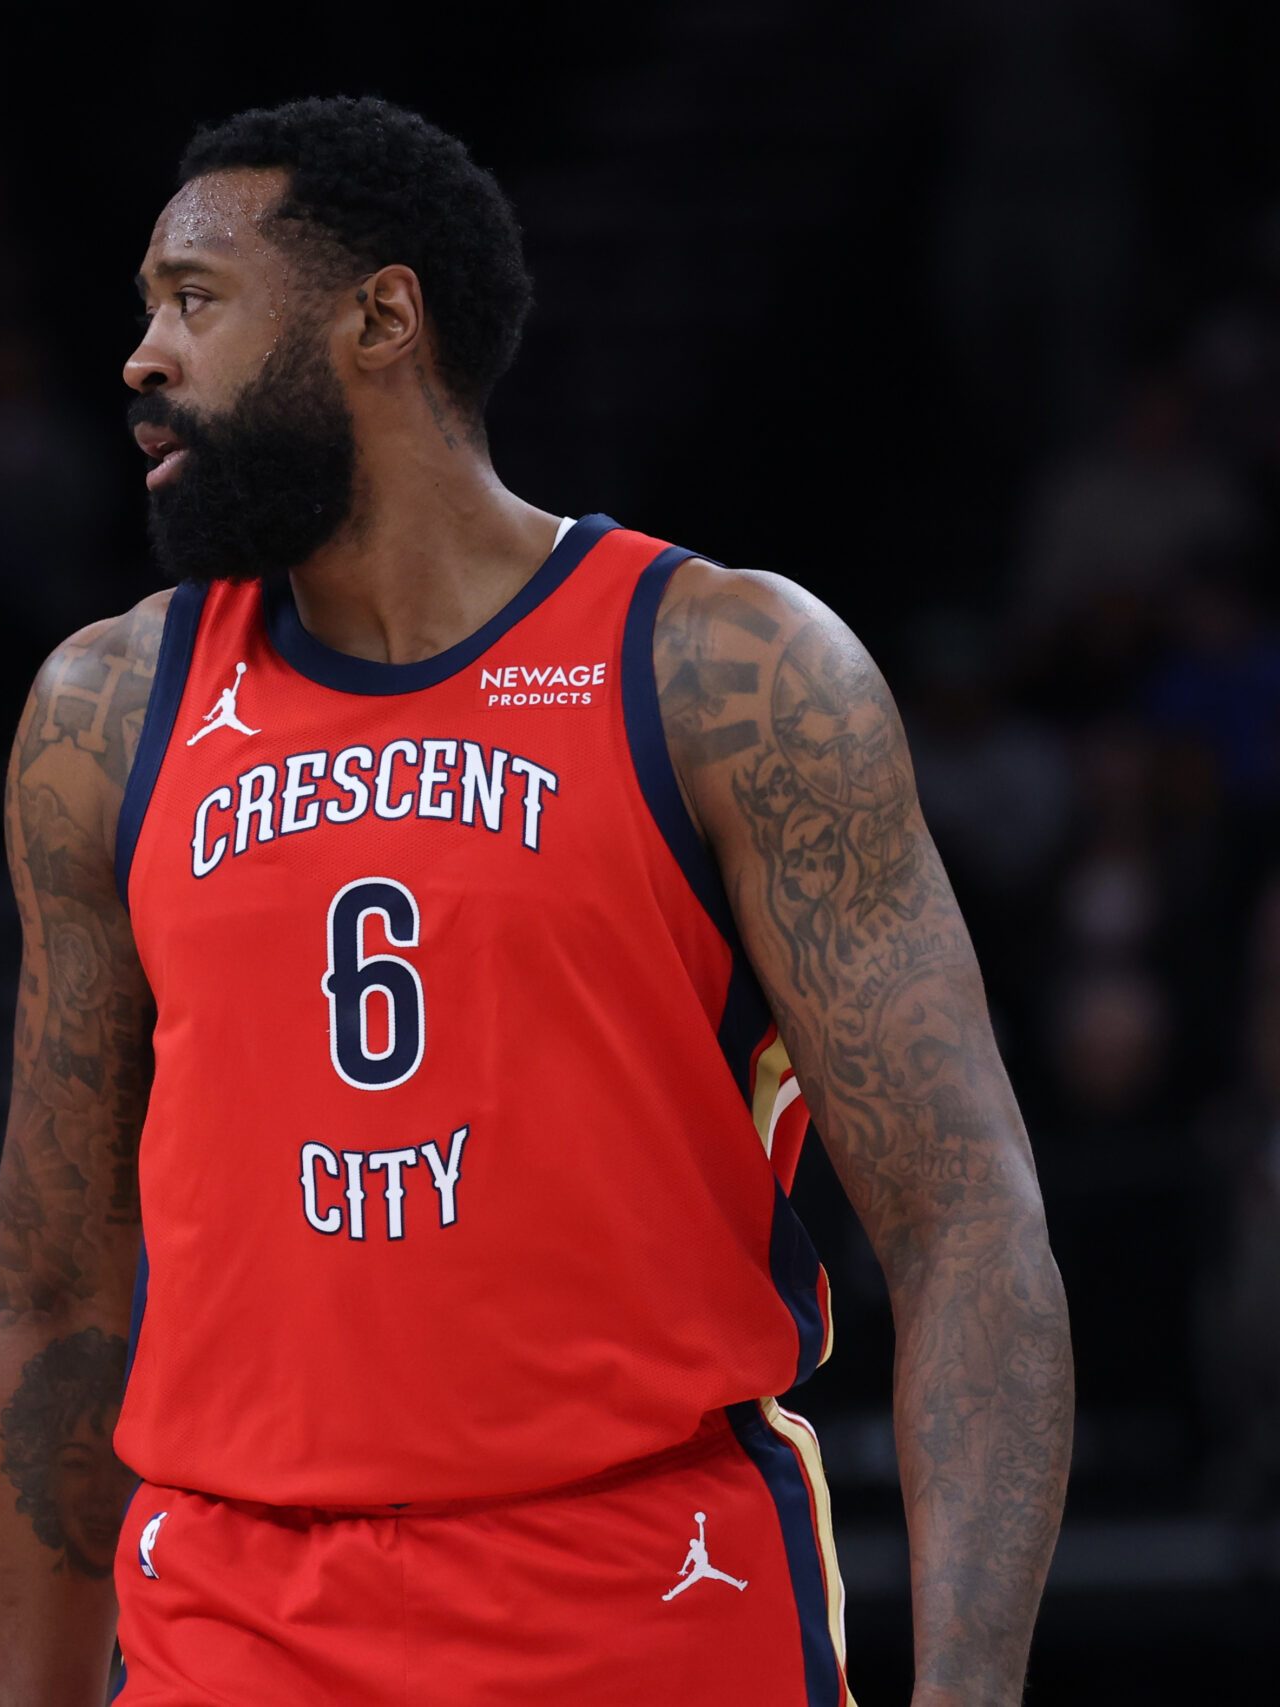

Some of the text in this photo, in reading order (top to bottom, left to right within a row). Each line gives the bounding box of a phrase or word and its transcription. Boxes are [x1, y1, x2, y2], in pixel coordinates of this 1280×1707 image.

[480, 662, 606, 690] NEWAGE
[487, 691, 592, 707] PRODUCTS
[191, 737, 558, 879] CRESCENT
[321, 876, 425, 1091] 6
[300, 1123, 469, 1241] CITY
